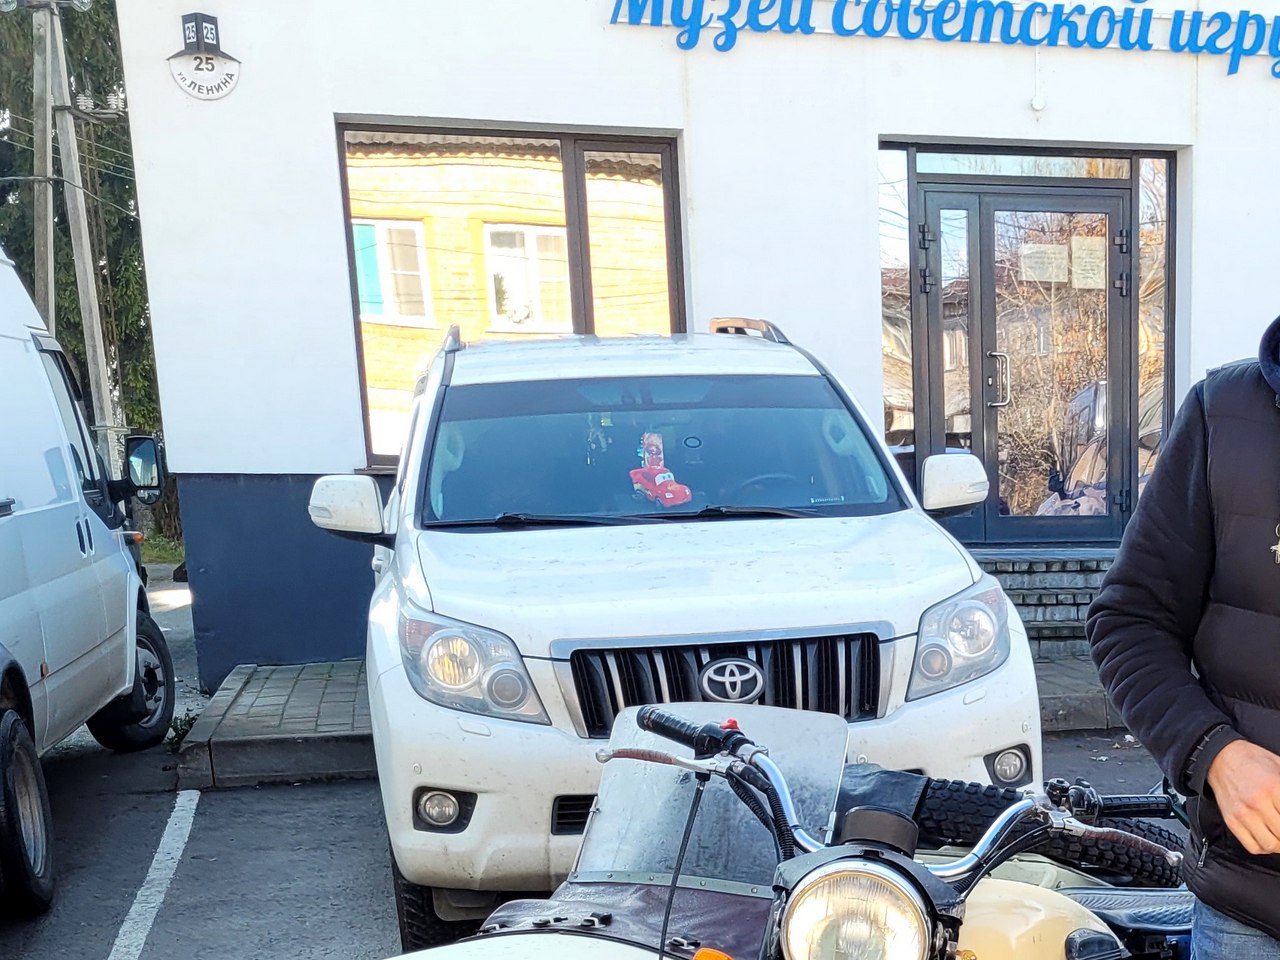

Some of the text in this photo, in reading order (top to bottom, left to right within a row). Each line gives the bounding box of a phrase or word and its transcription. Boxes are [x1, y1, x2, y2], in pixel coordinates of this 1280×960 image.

[187, 25, 196, 40] 25
[831, 0, 1154, 50] советской
[204, 26, 216, 42] 25
[193, 56, 215, 72] 25
[177, 72, 235, 95] ул. ЛЕНИНА
